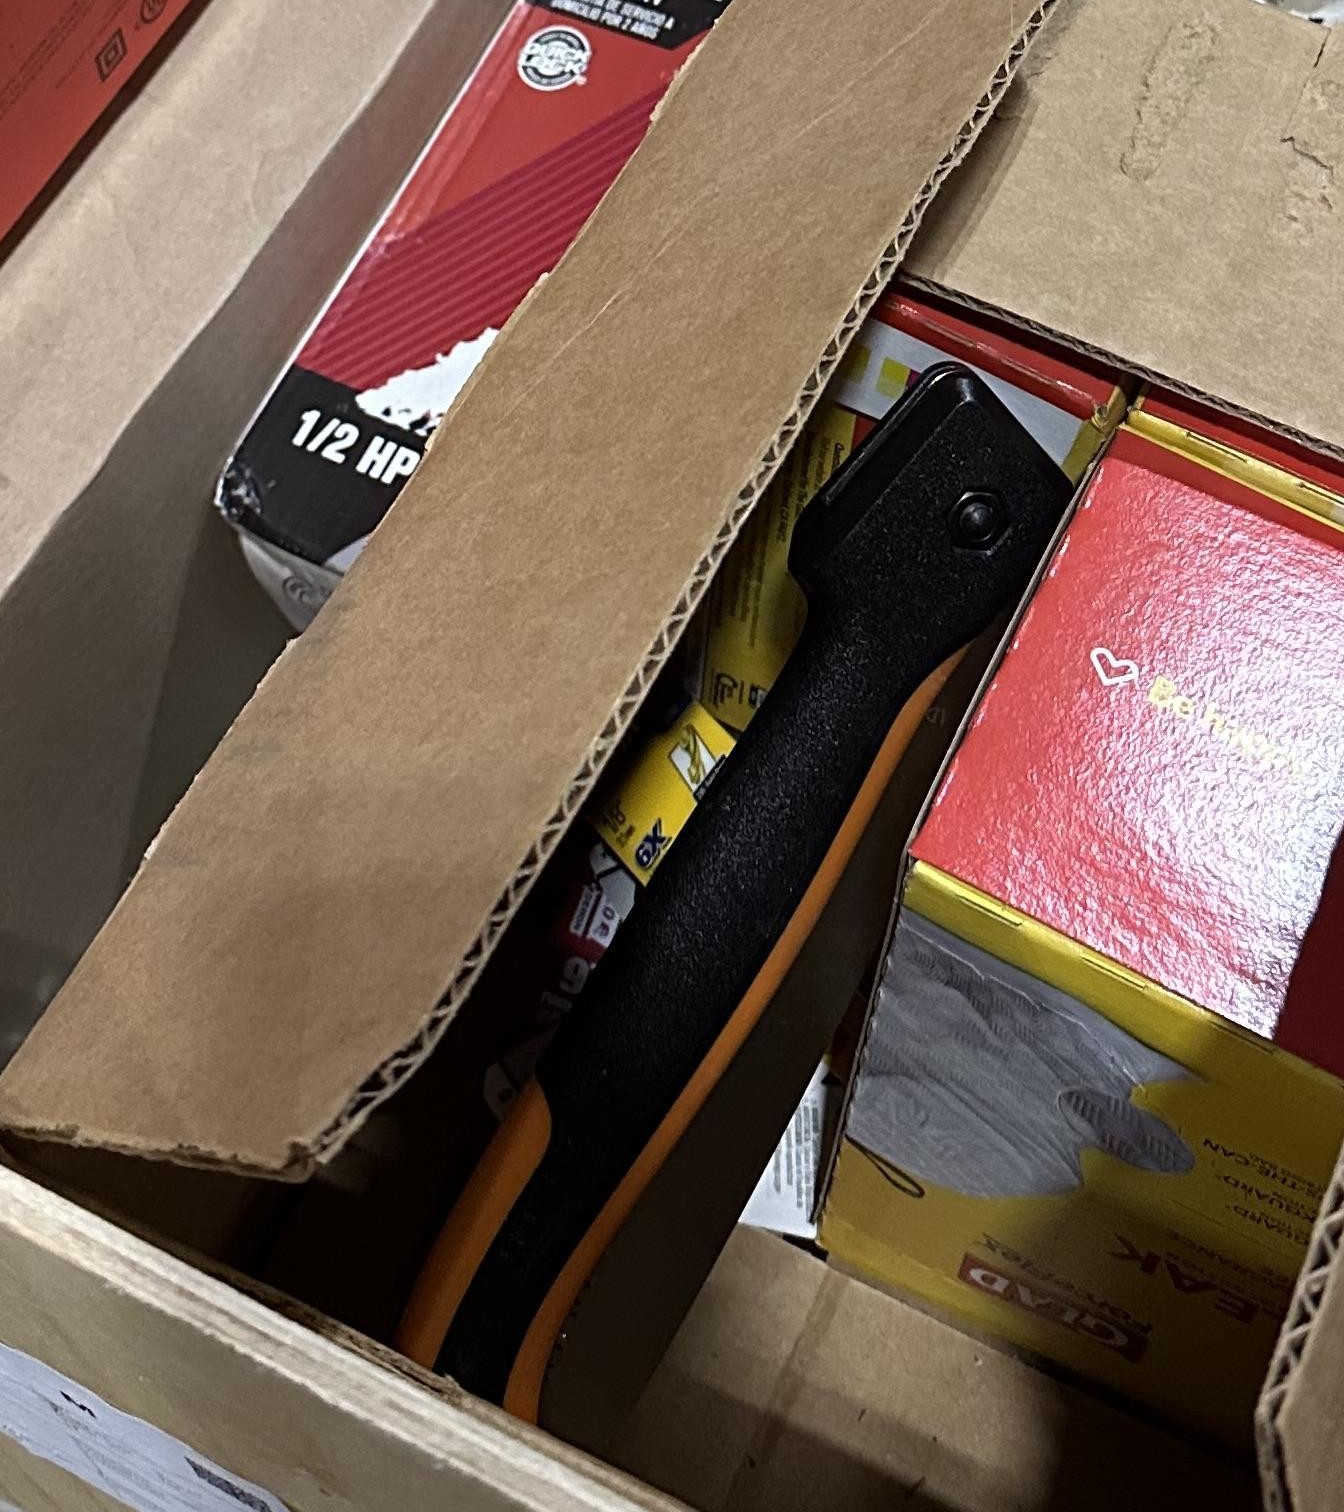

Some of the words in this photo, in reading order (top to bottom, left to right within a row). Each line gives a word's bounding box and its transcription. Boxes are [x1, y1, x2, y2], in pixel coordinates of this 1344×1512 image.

[290, 408, 360, 465] 1/2
[355, 434, 422, 487] HP
[1108, 1232, 1262, 1326] EAK
